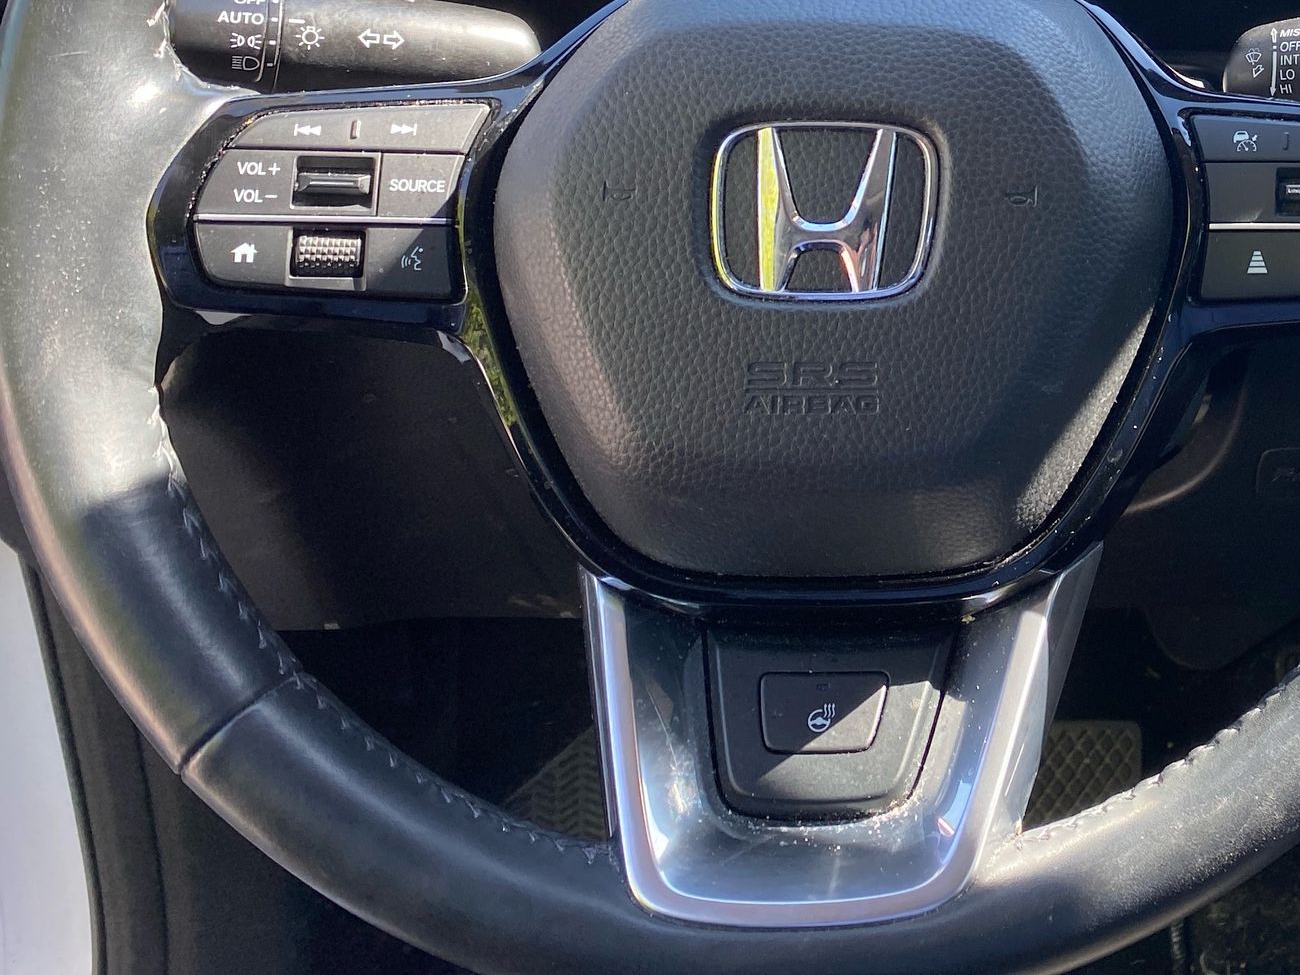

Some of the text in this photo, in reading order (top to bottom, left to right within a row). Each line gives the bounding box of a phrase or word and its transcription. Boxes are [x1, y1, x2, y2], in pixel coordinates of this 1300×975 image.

[217, 10, 265, 25] AUTO
[1279, 54, 1300, 66] INT
[1279, 69, 1295, 81] LO
[1279, 84, 1293, 94] HI
[389, 179, 446, 193] SOURCE
[747, 360, 879, 387] SRS
[744, 394, 880, 416] AIRBAG
